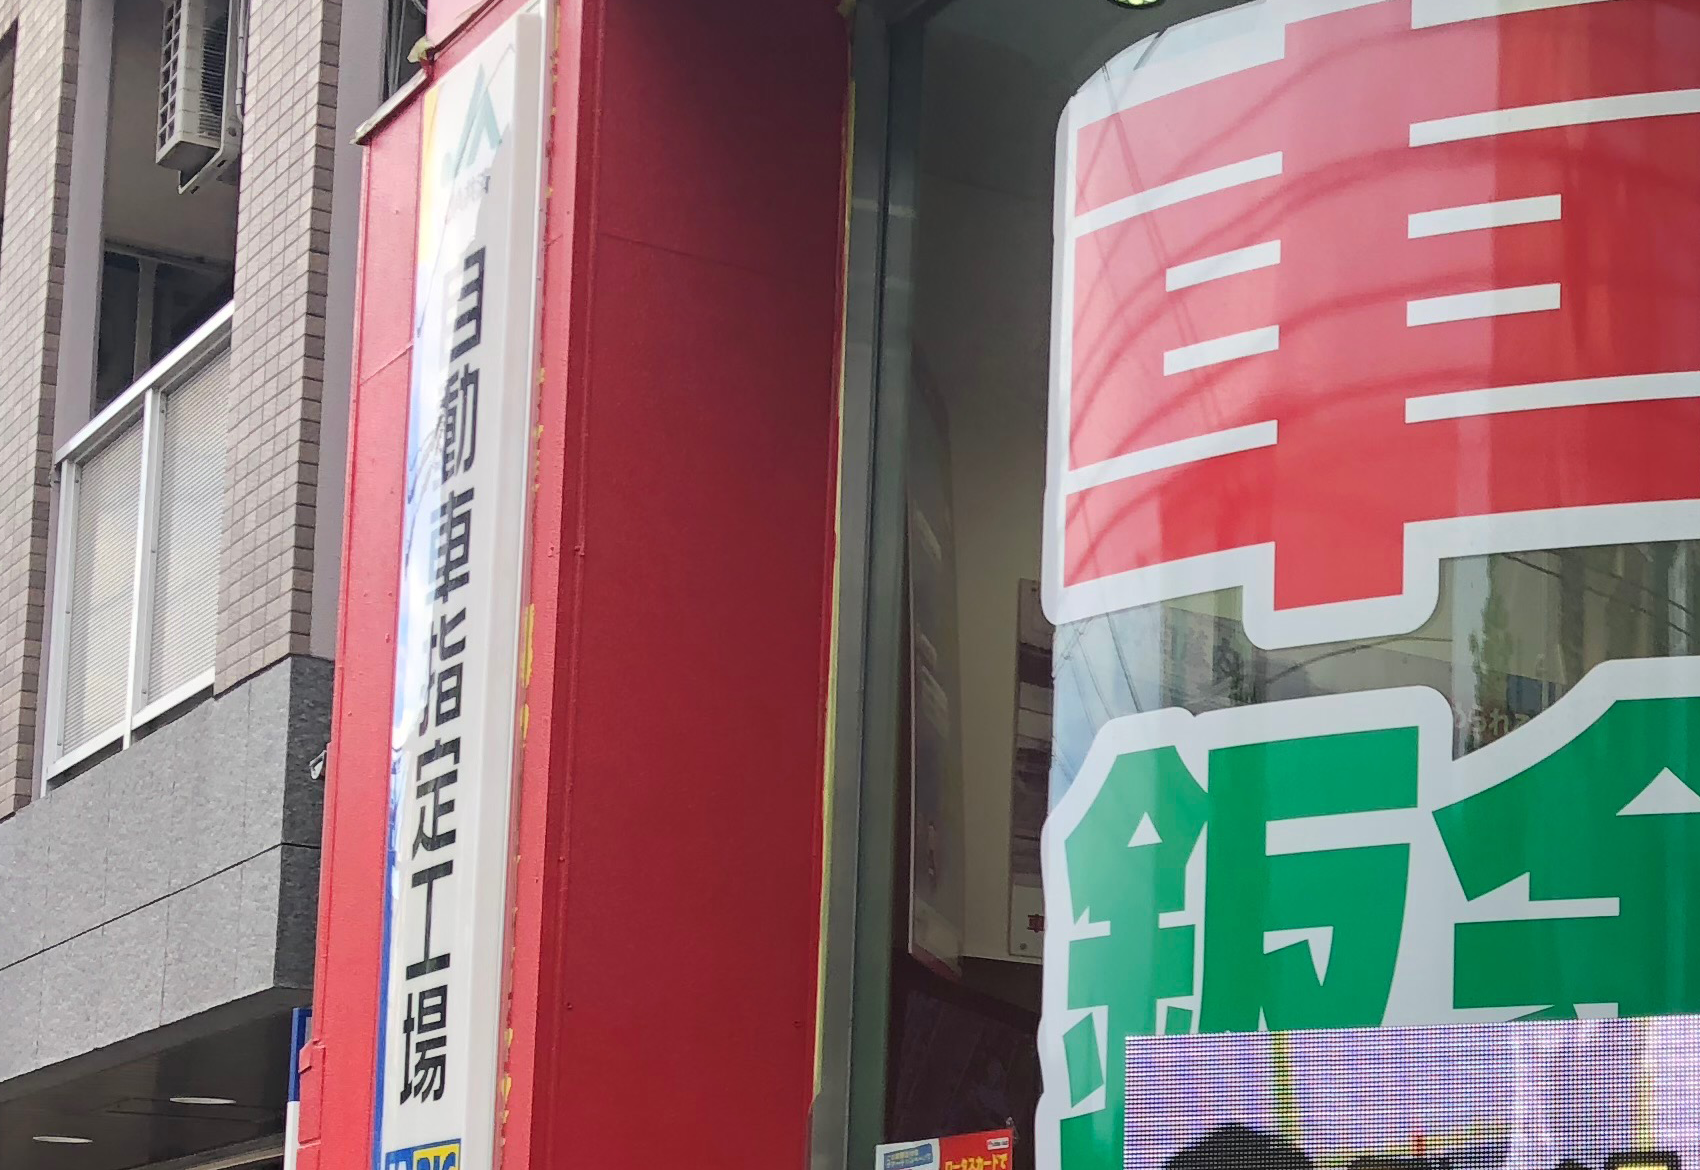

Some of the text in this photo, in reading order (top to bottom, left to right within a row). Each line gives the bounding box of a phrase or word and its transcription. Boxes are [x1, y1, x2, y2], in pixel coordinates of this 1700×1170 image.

[399, 246, 487, 1106] 自動車指定工場
